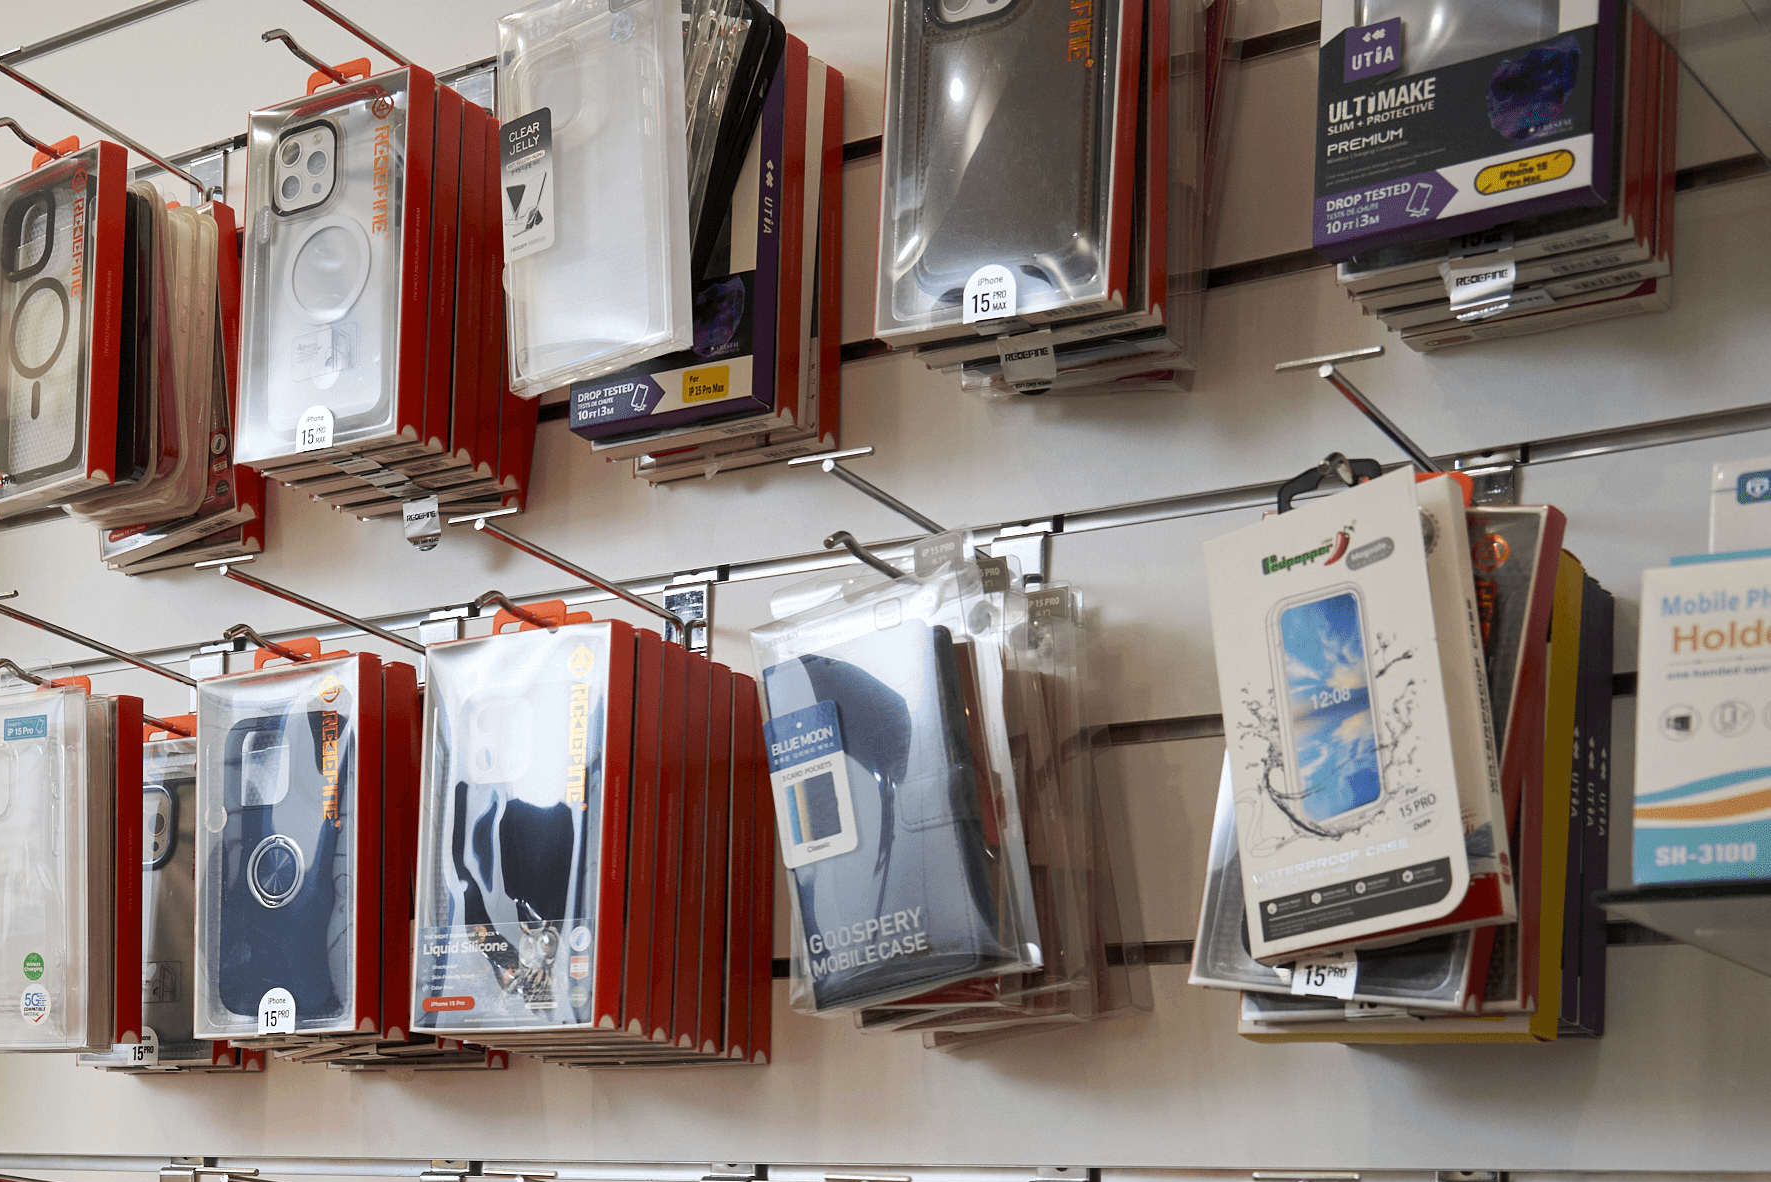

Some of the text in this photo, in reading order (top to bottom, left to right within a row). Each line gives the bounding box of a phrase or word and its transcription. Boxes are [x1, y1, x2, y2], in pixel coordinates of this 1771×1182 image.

[1328, 120, 1354, 136] SLIM
[1367, 101, 1434, 127] PROTECTIVE
[508, 121, 540, 144] CLEAR
[1327, 128, 1403, 156] PREMIUM
[509, 136, 540, 156] JELLY
[1326, 182, 1411, 212] DROP TESTED
[978, 276, 1004, 287] iPhone
[972, 290, 1007, 314] 15 PRO
[993, 301, 1007, 311] MAX
[689, 375, 700, 383] For
[703, 385, 712, 394] Pro
[713, 383, 727, 393] Max
[577, 383, 634, 403] DROP TESTED
[302, 428, 314, 446] 15
[1660, 588, 1740, 617] Mobile
[1310, 690, 1351, 709] 12:08
[787, 770, 803, 780] CARD
[805, 761, 832, 775] POCKETS
[1399, 794, 1436, 818] 15 PRO
[1364, 838, 1409, 860] CASE
[1655, 842, 1758, 866] SH-3100
[809, 906, 922, 955] GOOSPERY
[423, 939, 508, 957] Liquid Silicone
[1305, 965, 1347, 986] 15 PRO
[24, 992, 39, 1007] 5G
[267, 997, 286, 1005] iPhone
[430, 1000, 447, 1008] iPhone
[264, 1010, 290, 1027] 15 PRO
[132, 1045, 154, 1061] 15 PRO
